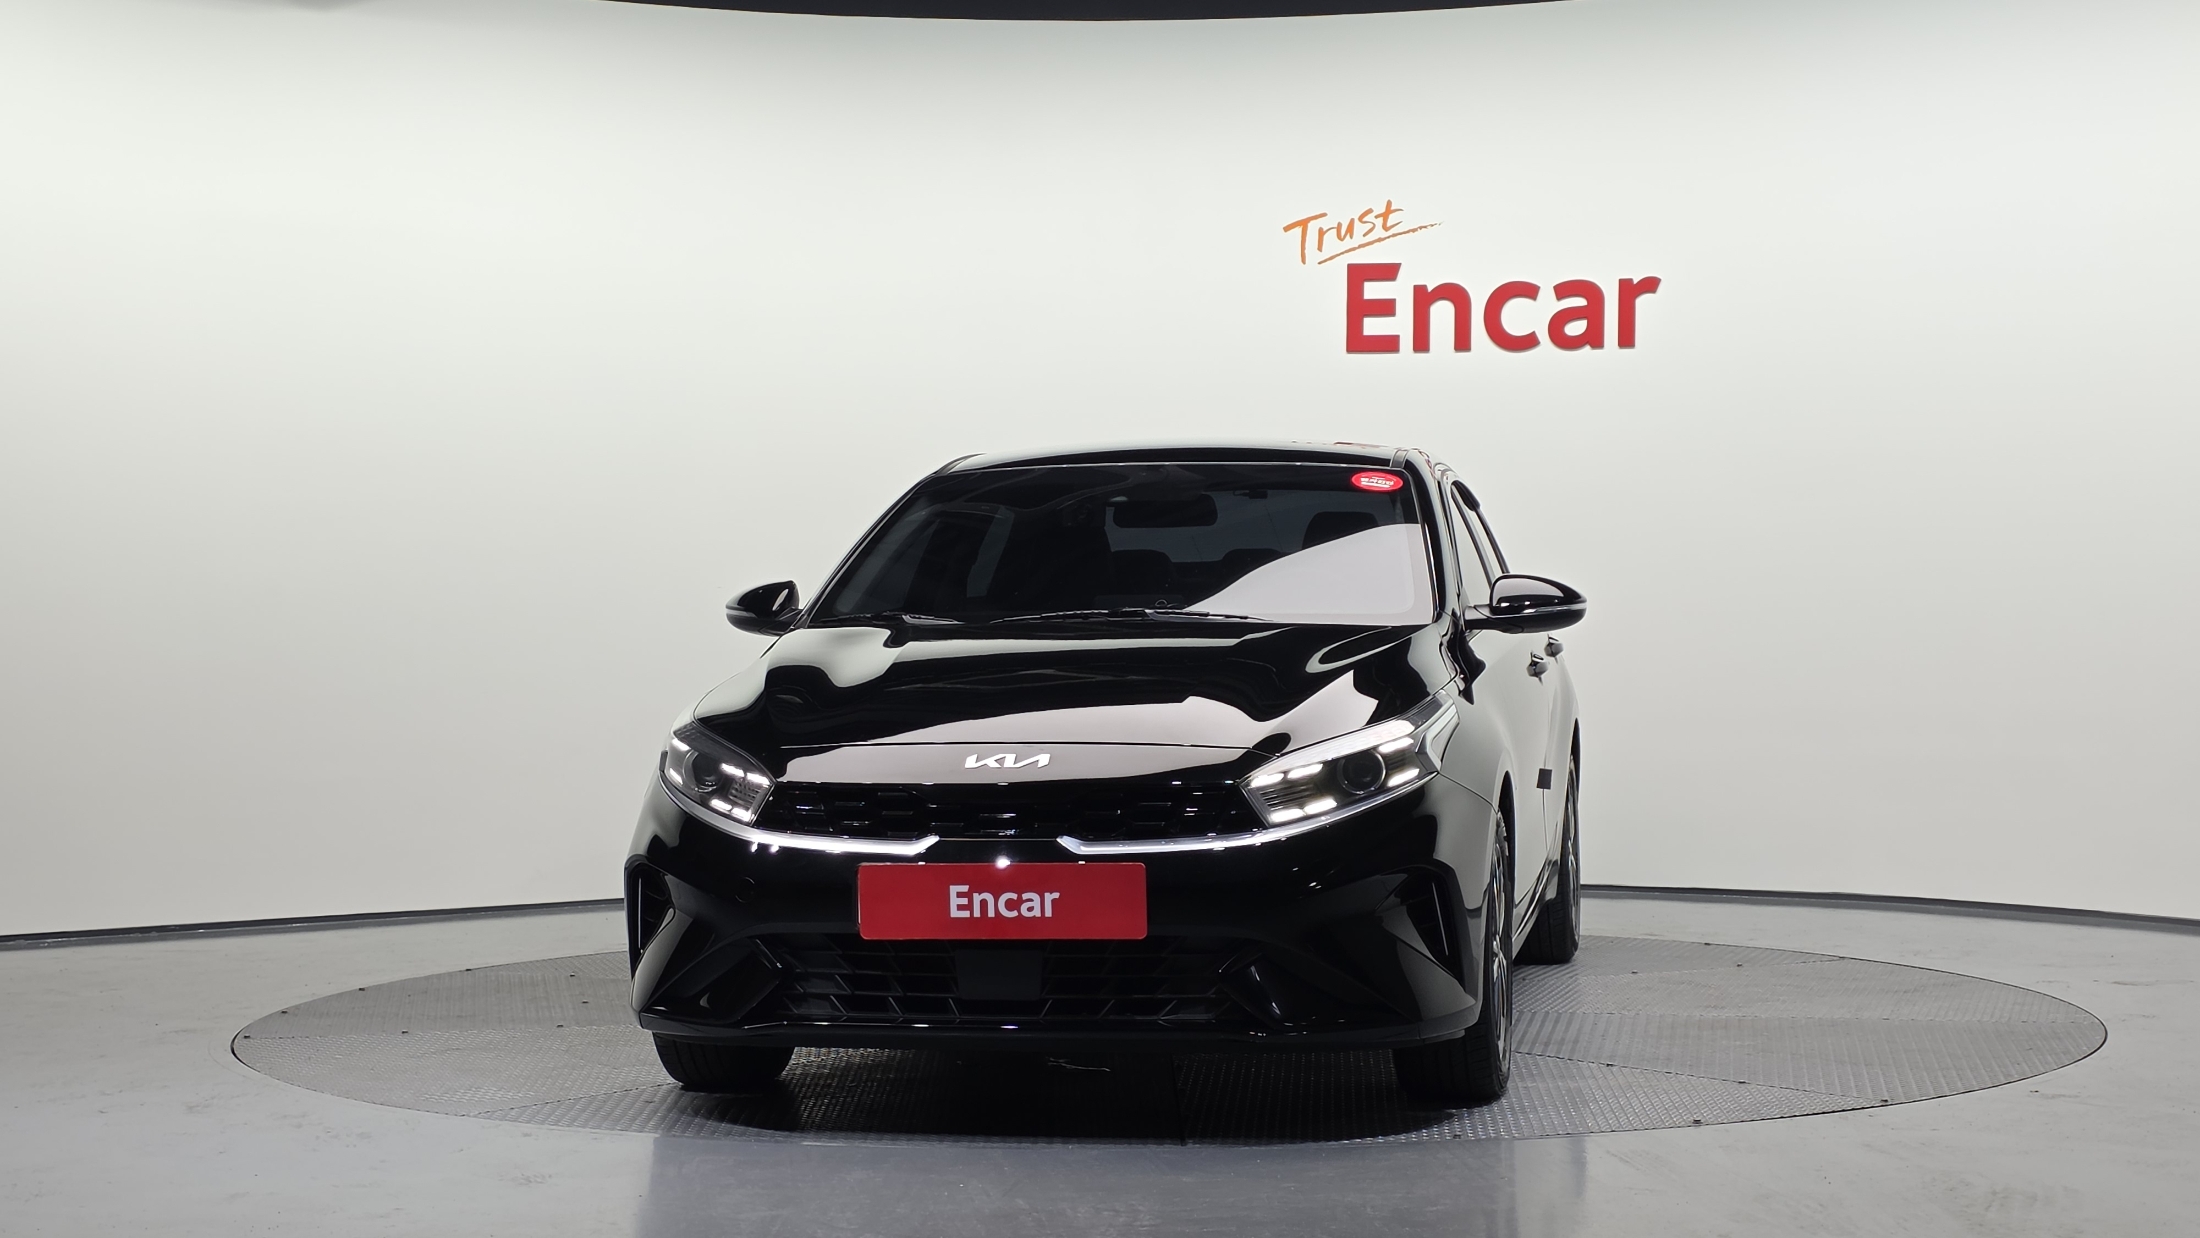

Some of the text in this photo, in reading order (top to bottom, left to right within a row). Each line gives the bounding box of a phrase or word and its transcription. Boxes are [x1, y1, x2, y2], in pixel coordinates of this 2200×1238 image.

[1283, 199, 1404, 265] Trust
[1345, 263, 1661, 353] Encar
[949, 885, 1060, 918] Encar
